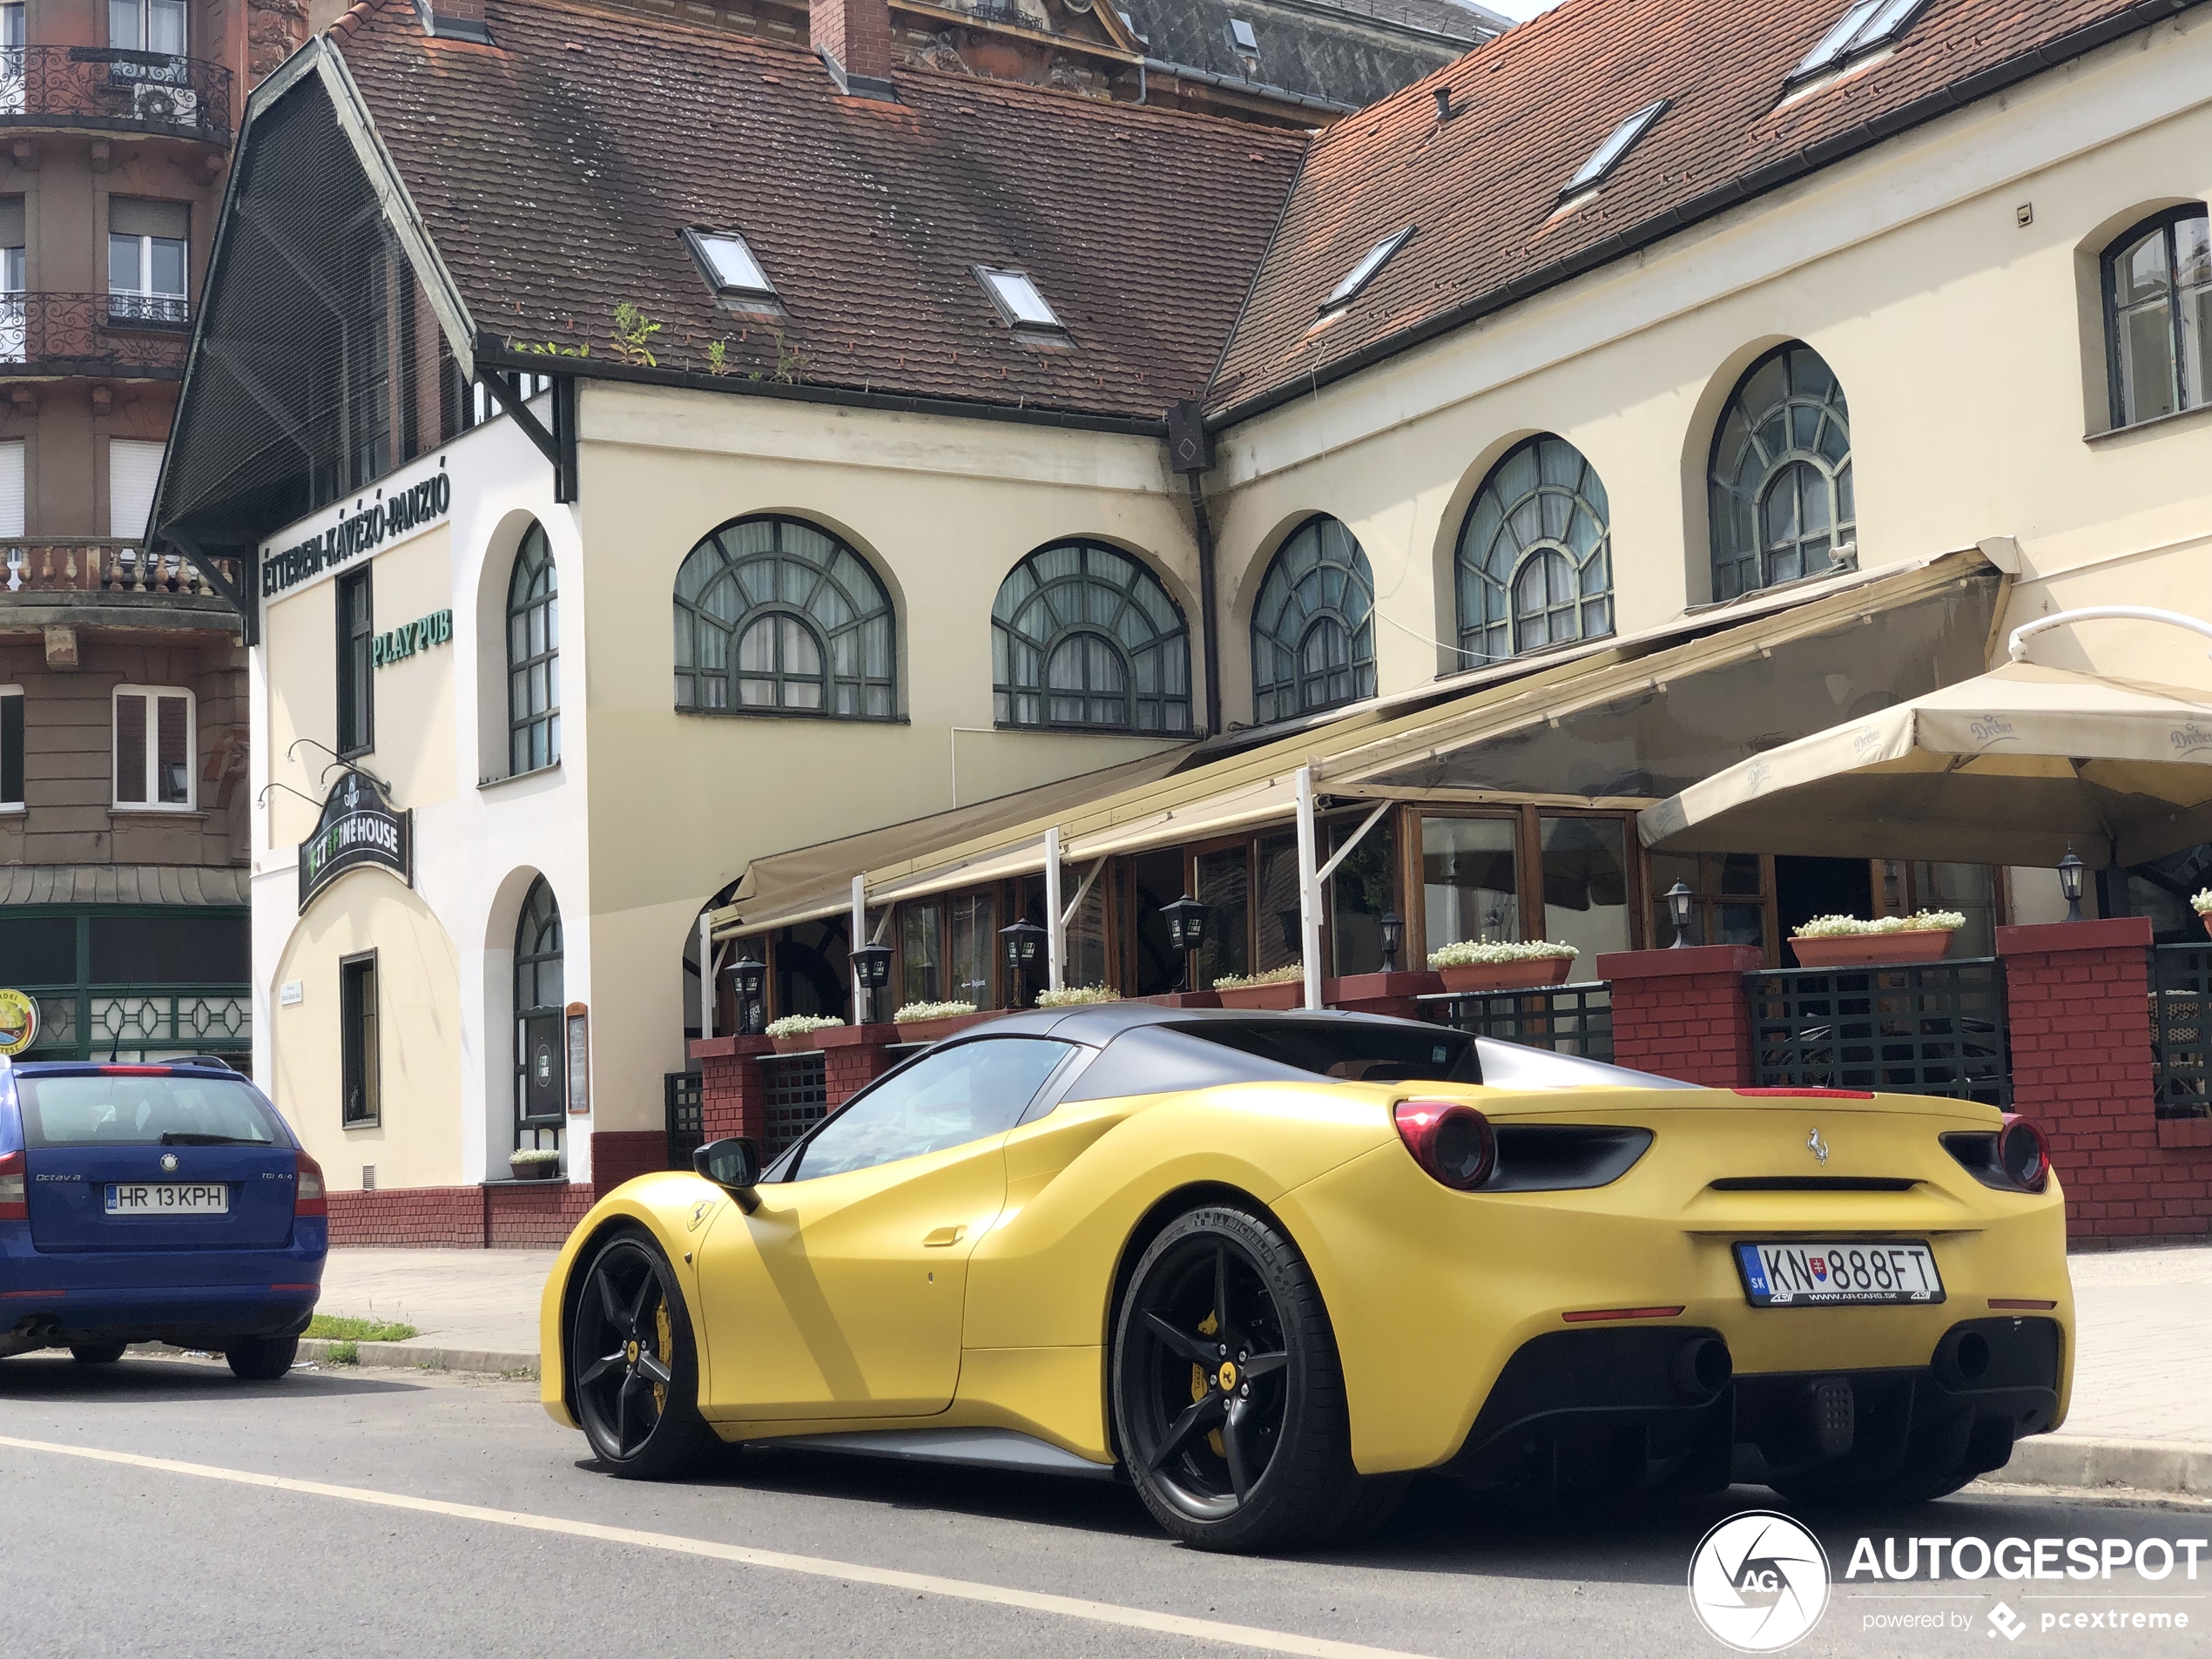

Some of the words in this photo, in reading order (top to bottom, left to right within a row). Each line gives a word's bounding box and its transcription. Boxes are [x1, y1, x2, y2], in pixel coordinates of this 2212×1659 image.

[262, 455, 450, 597] ÉTTEREM-KÁVÉZÓ-PANZIÓ
[372, 622, 418, 668] PLAY
[416, 608, 454, 651] PUB
[357, 818, 397, 853] HOUSE
[118, 1188, 148, 1207] HR
[156, 1188, 174, 1206] 13
[179, 1188, 221, 1206] KPH
[1224, 1217, 1275, 1266] MICHELIN
[1750, 1278, 1765, 1289] SK
[1764, 1249, 1815, 1291] KN
[1827, 1250, 1929, 1291] 888FT
[1808, 1292, 1897, 1301] WWW.AR-CARS.SK
